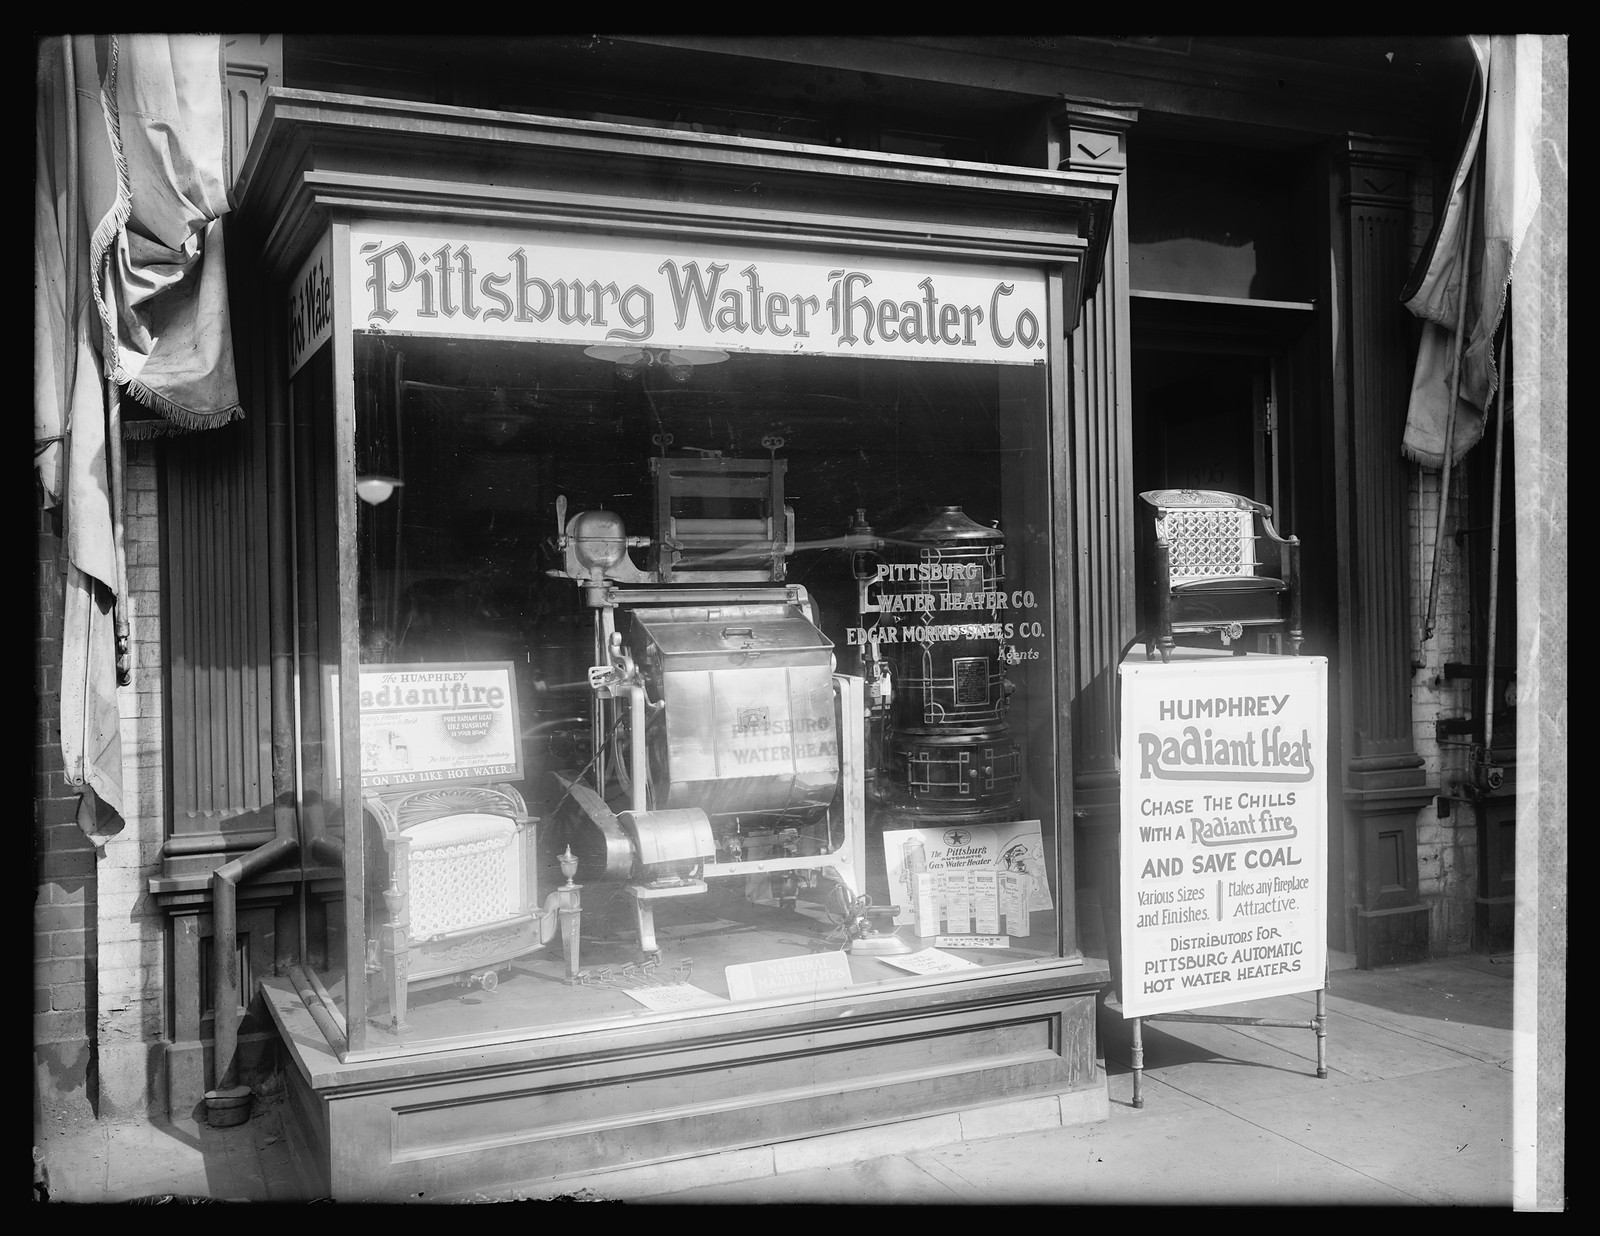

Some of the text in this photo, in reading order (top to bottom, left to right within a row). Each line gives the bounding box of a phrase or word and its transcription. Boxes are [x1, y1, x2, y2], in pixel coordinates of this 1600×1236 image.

[305, 256, 331, 344] Wate
[359, 241, 1046, 350] Pittsburg Water Heater Co.
[876, 562, 978, 581] PITTSBURG
[876, 590, 1038, 613] WATER HEATER CO.
[846, 621, 1045, 646] EDGAR MORRIS SALES CO.
[997, 645, 1040, 664] Agents
[382, 672, 468, 683] The HUMPHREY
[361, 682, 505, 711] adiantfire
[1159, 694, 1290, 721] HUMPHREY
[443, 713, 492, 723] PURE RADIANT HEAT
[461, 721, 489, 729] SUNSHINE
[1138, 725, 1313, 780] Radiant Heat
[372, 775, 389, 786] ON
[393, 773, 416, 784] TAP
[420, 771, 444, 782] LIKE
[447, 768, 470, 779] HOT
[473, 765, 511, 776] WATER
[1140, 792, 1296, 817] CHASE THE CHILLS
[1139, 826, 1172, 843] WITH
[1175, 825, 1186, 841] A
[928, 858, 992, 869] Gas Water Heater
[931, 846, 987, 858] The Pittsburg
[1140, 846, 1302, 879] AND SAVE COAL
[1137, 886, 1205, 906] Various Sizes
[1228, 876, 1309, 897] Makes any Fireplace
[1136, 906, 1210, 929] and Finishes.
[1233, 896, 1299, 918] Attractive.
[1170, 926, 1282, 952] DISTRIBUTORS FOR
[1144, 941, 1303, 975] PITTSBURG AUTOMATIC
[757, 972, 803, 990] MAZDA
[803, 967, 846, 984] LAMPS
[1143, 959, 1301, 994] HOT WATER HEATERS
